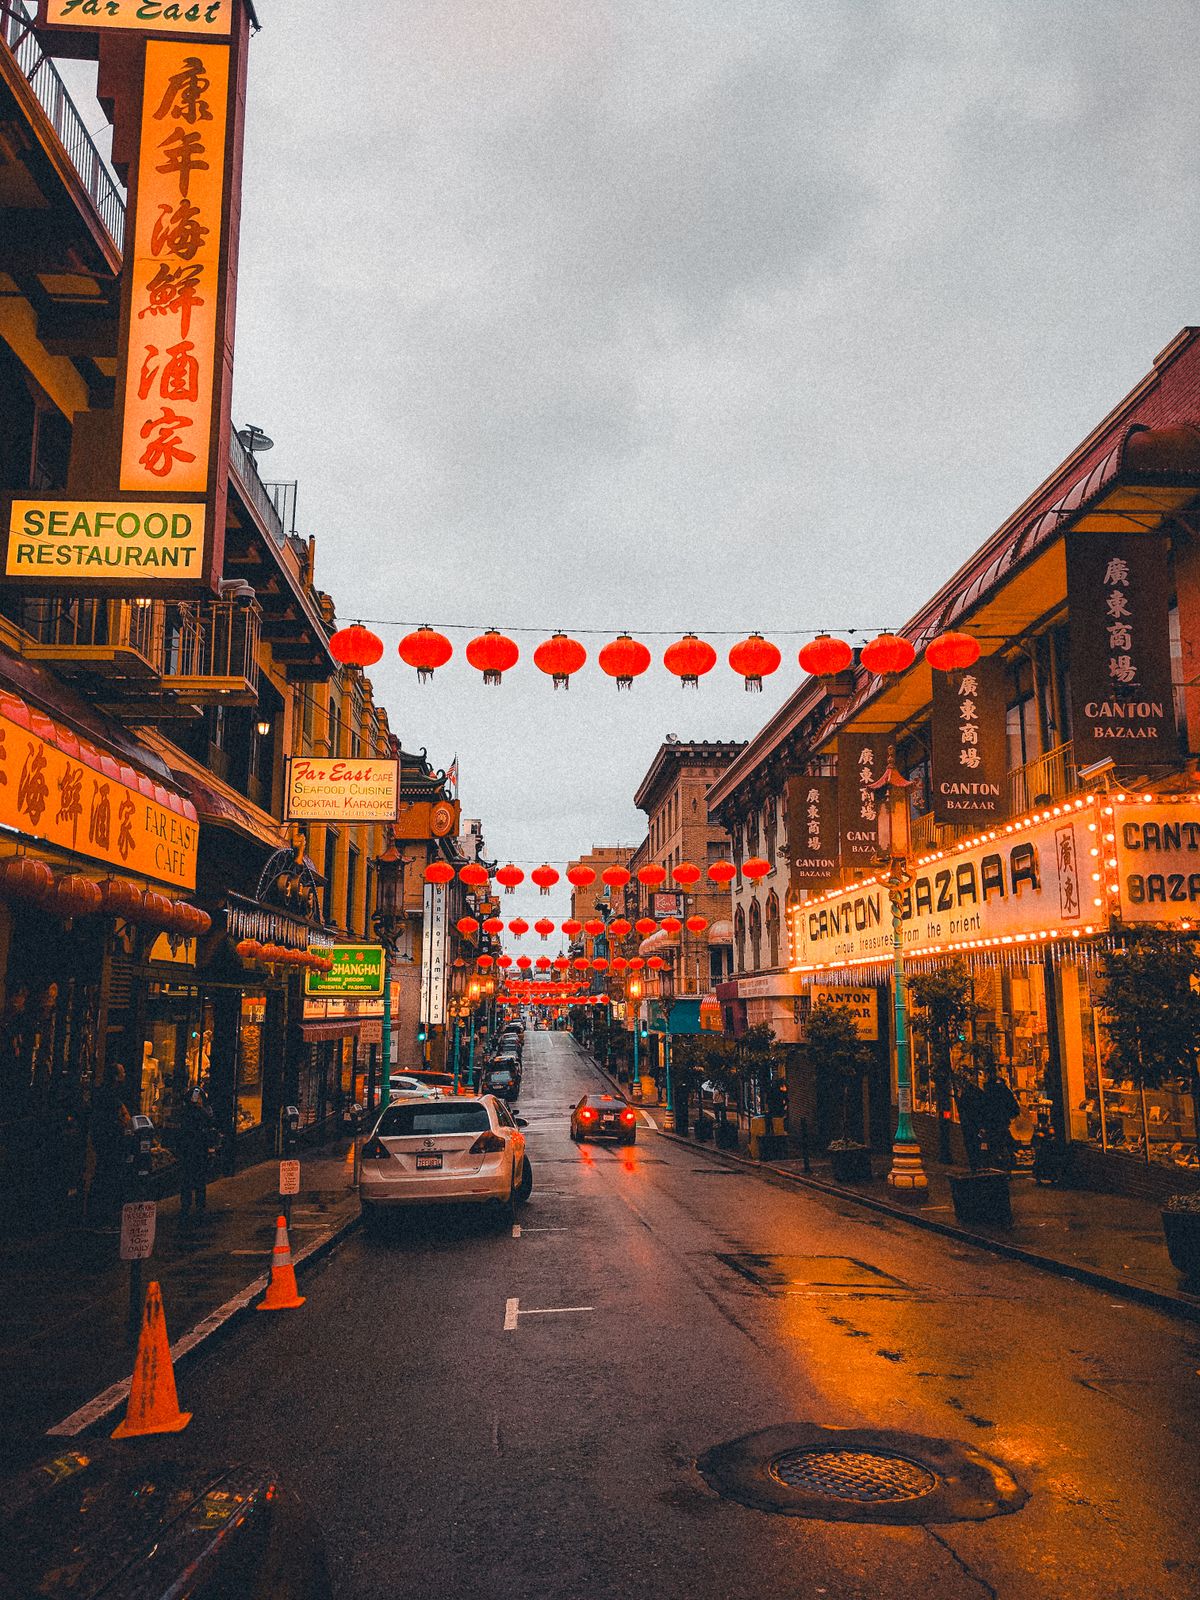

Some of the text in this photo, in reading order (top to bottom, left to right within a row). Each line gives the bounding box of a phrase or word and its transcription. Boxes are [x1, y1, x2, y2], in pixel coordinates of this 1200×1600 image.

[138, 57, 214, 477] 康年海鮮酒家
[24, 510, 192, 539] SEAFOOD
[17, 544, 196, 567] RESTAURANT
[1103, 558, 1137, 683] 廣東商場
[1084, 702, 1163, 718] CANTON
[958, 675, 982, 769] 廣東商場
[1094, 727, 1158, 738] BAZAAR
[294, 762, 326, 781] Far
[329, 763, 372, 781] East
[0, 728, 136, 861] 海鮮酒家
[294, 782, 393, 796] SEAFOOD CUISINE
[940, 782, 999, 796] CANTON
[291, 796, 394, 809] COCKTAIL KARAOKE
[946, 801, 995, 810] BAZAAR
[145, 806, 197, 852] FAR EAST
[806, 788, 821, 851] 廣東商場
[795, 859, 835, 867] CANTON
[808, 892, 882, 941] CANTON
[927, 921, 941, 938] the
[949, 912, 980, 933] orient
[331, 964, 380, 975] SHANGHAI
[817, 992, 871, 1004] CANTON
